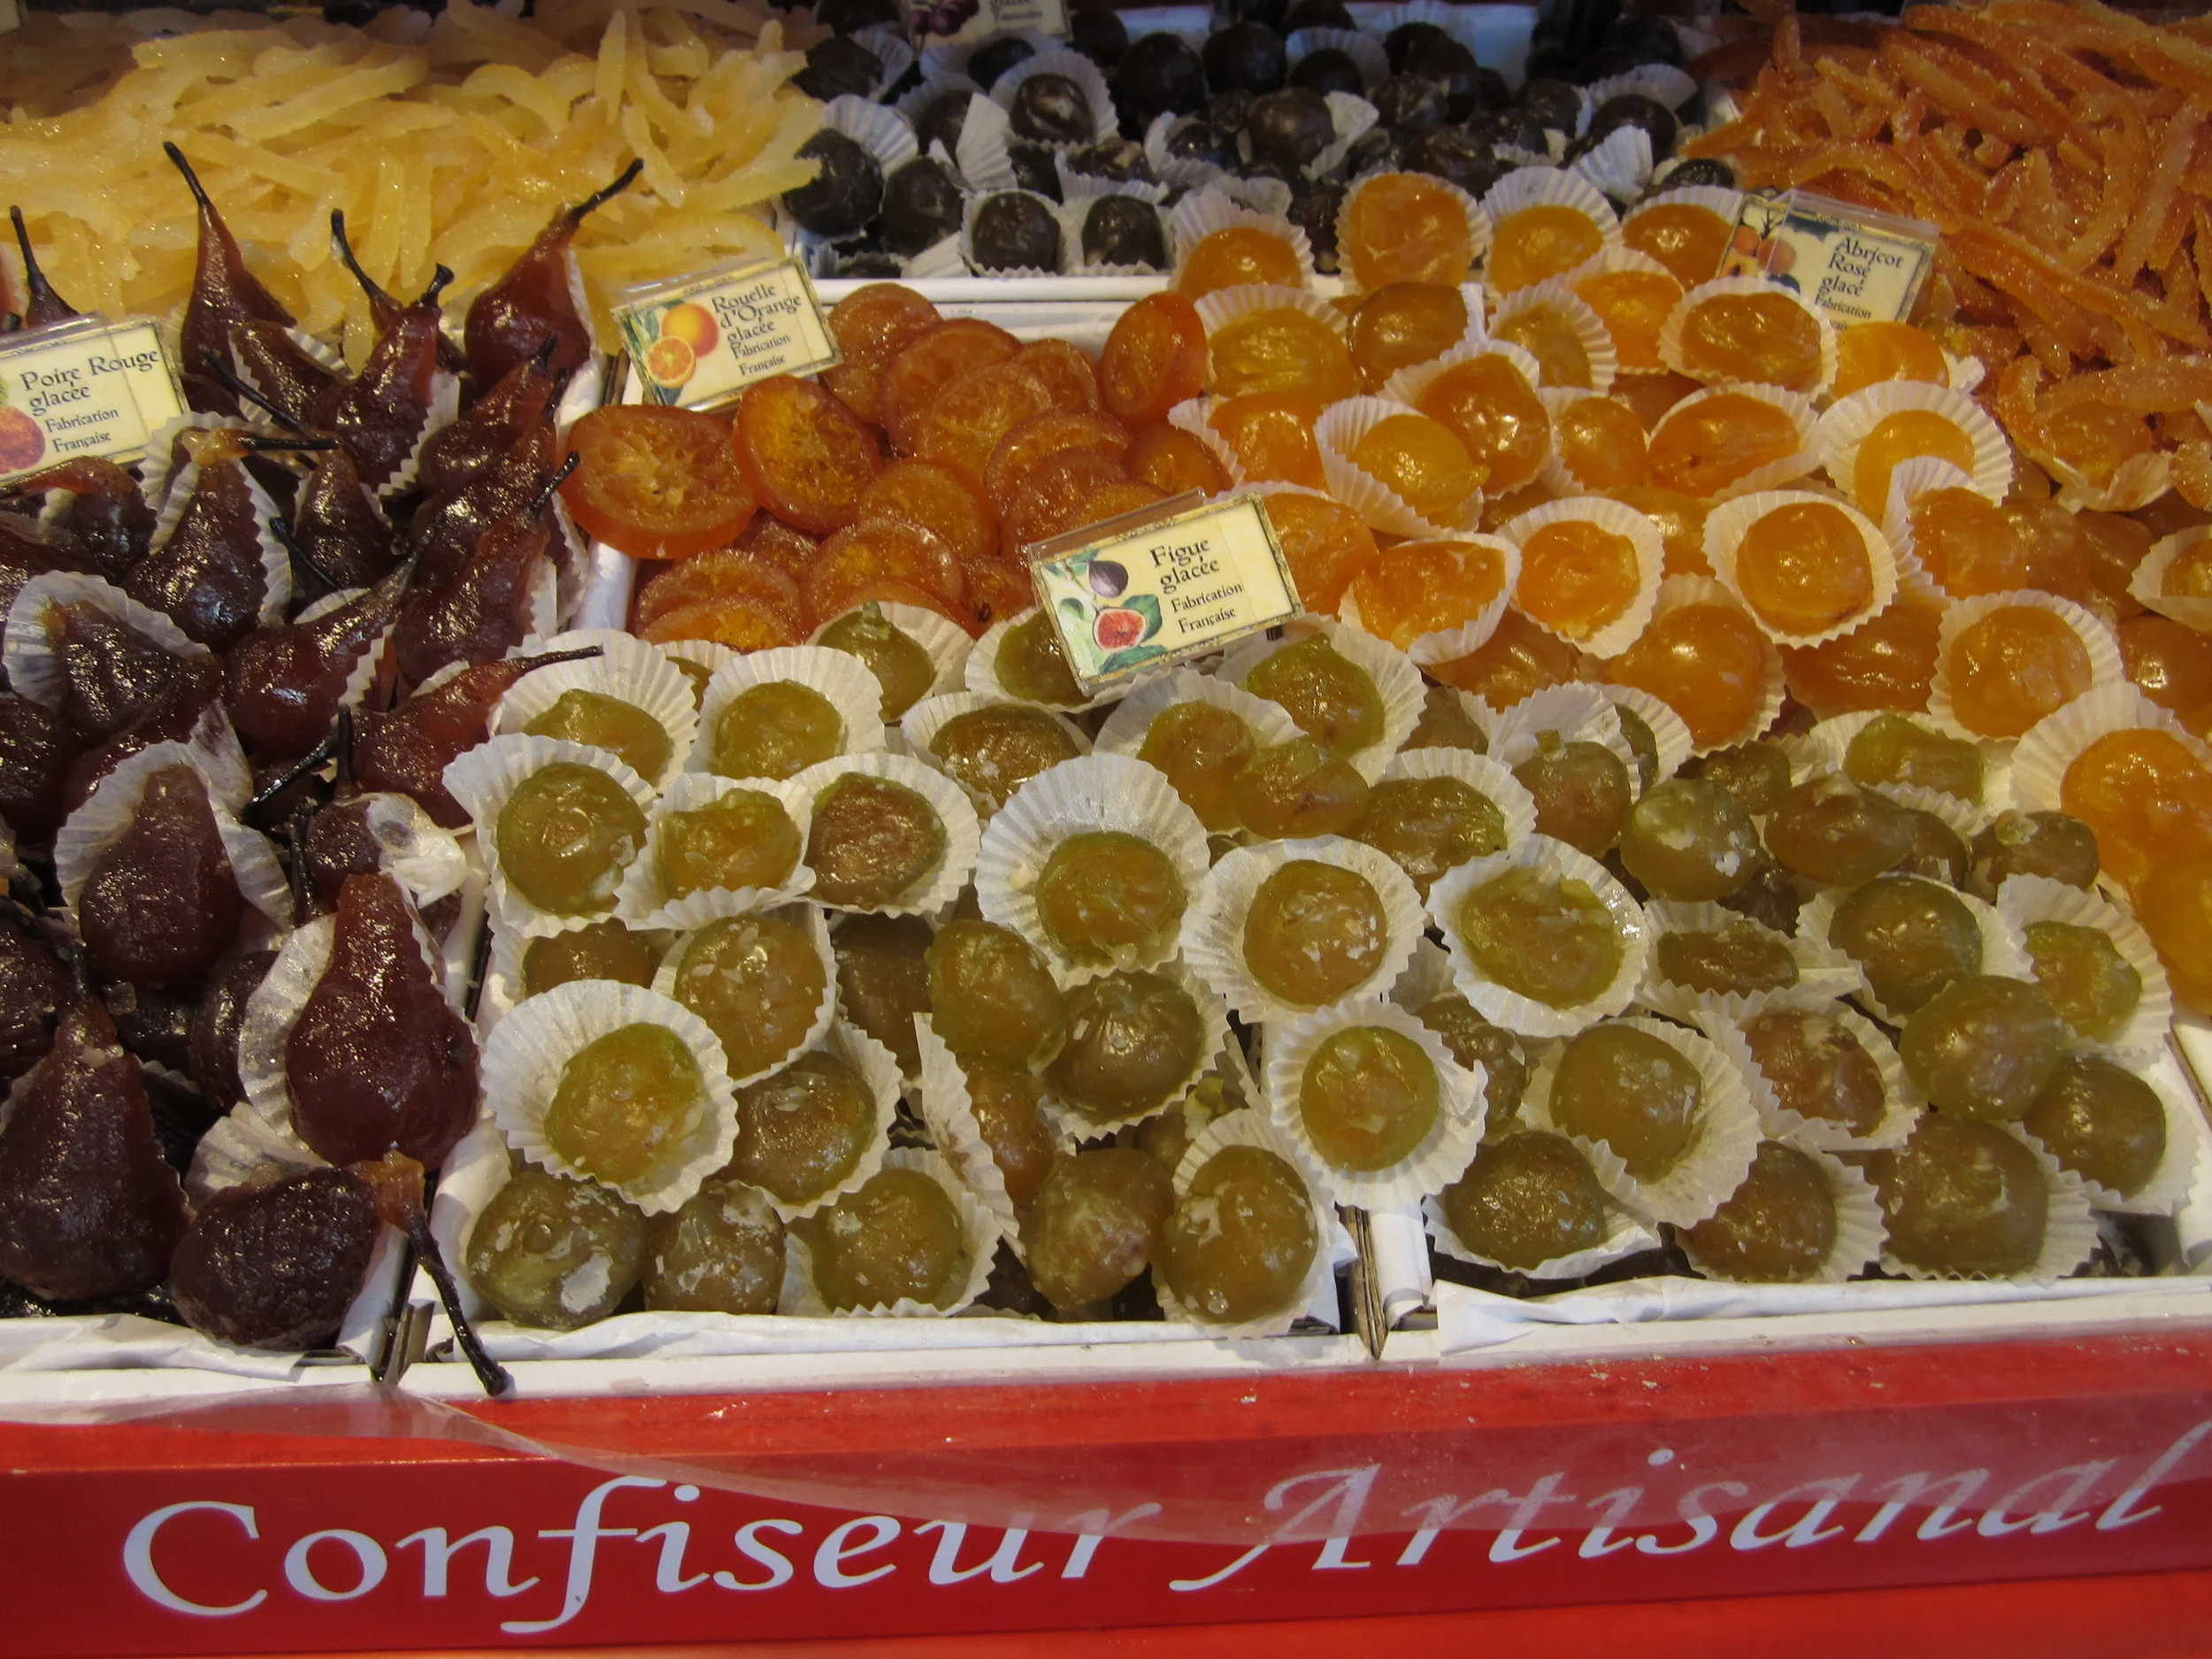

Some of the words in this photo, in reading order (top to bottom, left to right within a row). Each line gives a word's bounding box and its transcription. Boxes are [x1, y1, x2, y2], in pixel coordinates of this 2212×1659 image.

[1834, 236, 1903, 268] Abricot
[711, 284, 776, 313] Rouelle
[1818, 275, 1864, 297] glacé
[720, 296, 802, 328] d'Orange
[1815, 294, 1871, 319] Fabrication
[726, 318, 776, 348] glacée
[730, 334, 791, 359] Fabrication
[19, 368, 81, 391] Poire
[88, 350, 159, 376] Rouge
[739, 355, 786, 375] Française
[29, 380, 91, 417] glacée
[45, 408, 119, 433] Fabrication
[51, 431, 112, 453] Française
[1148, 538, 1211, 568] Figue
[1160, 556, 1221, 595] glacée
[1170, 581, 1243, 613] Fabrication
[1178, 606, 1237, 634] Française
[123, 1475, 1162, 1633] Confiseur
[1169, 1421, 2212, 1592] Artisanal
